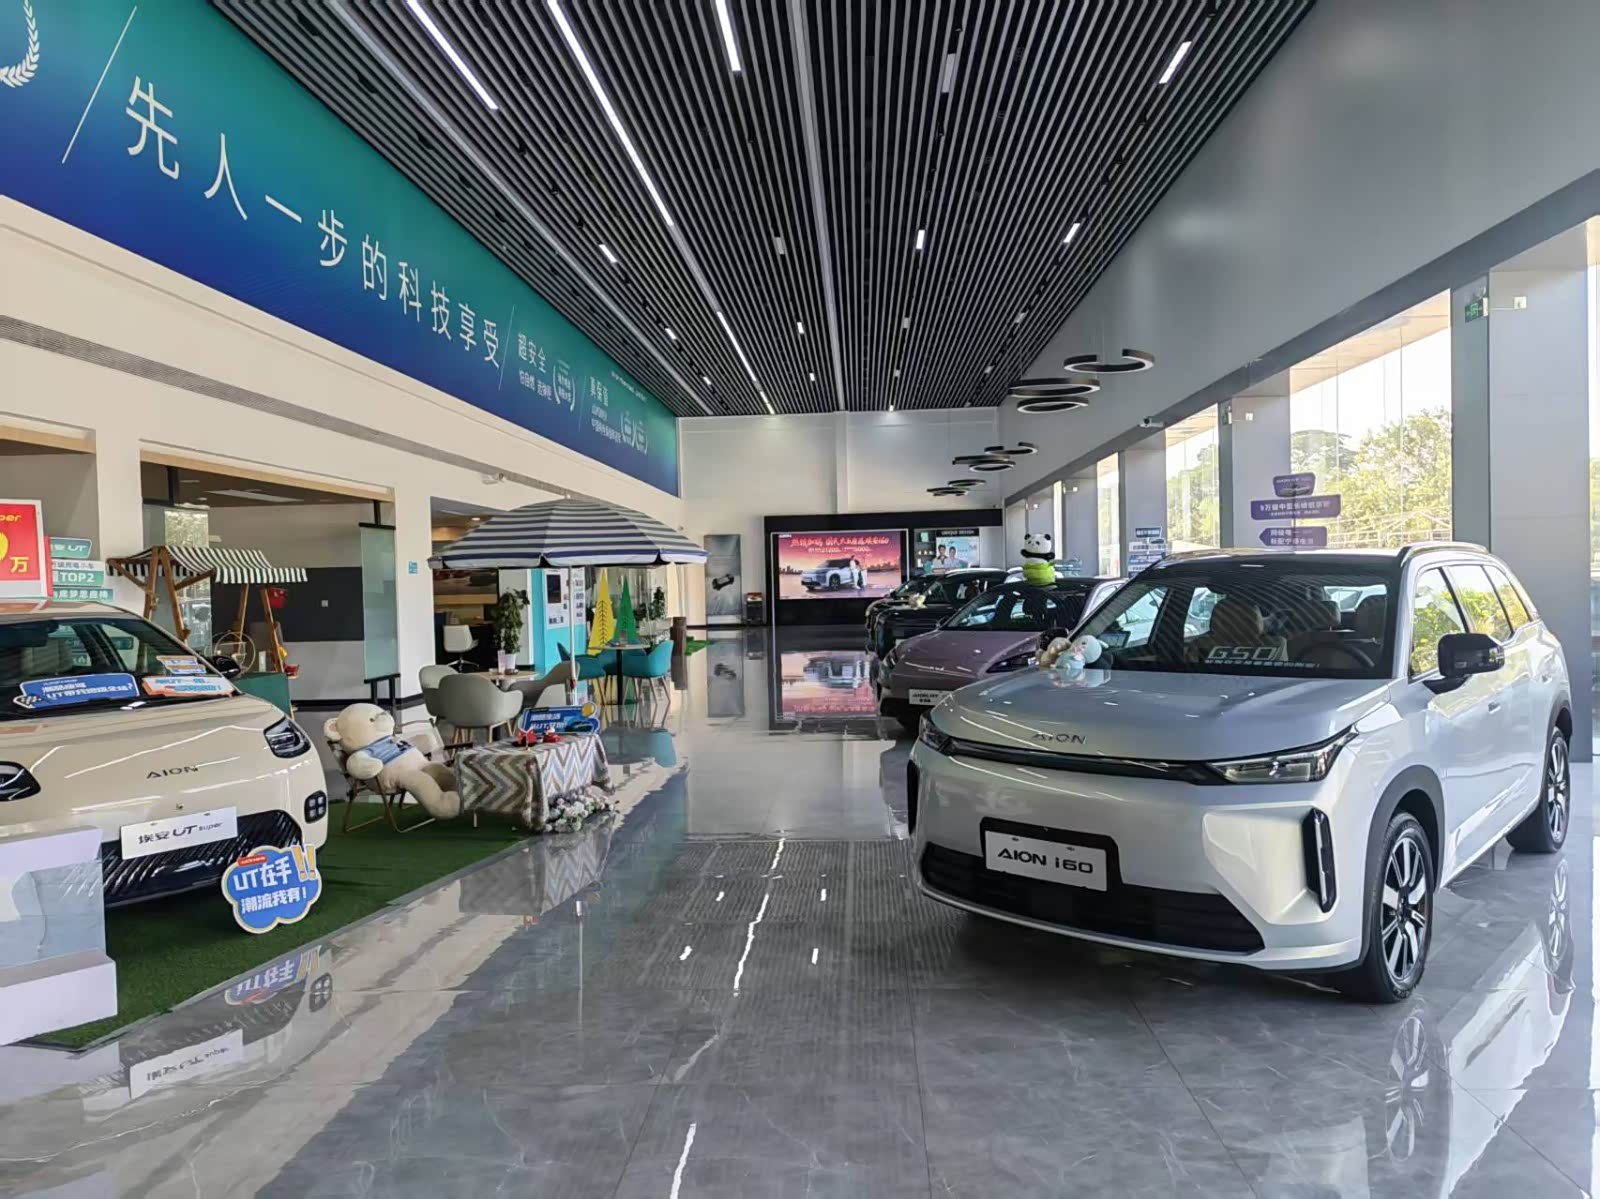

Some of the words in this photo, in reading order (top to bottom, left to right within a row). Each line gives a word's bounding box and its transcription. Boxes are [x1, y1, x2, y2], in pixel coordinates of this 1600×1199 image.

[125, 76, 500, 369] 先人一步的科技享受
[10, 556, 30, 573] 万
[1031, 732, 1087, 745] AION
[146, 766, 199, 779] AION
[138, 831, 170, 845] 埃安
[172, 824, 199, 837] UT
[199, 822, 223, 832] super
[997, 848, 1047, 866] AION
[1055, 857, 1093, 874] i60
[241, 886, 307, 915] 潮流我有!
